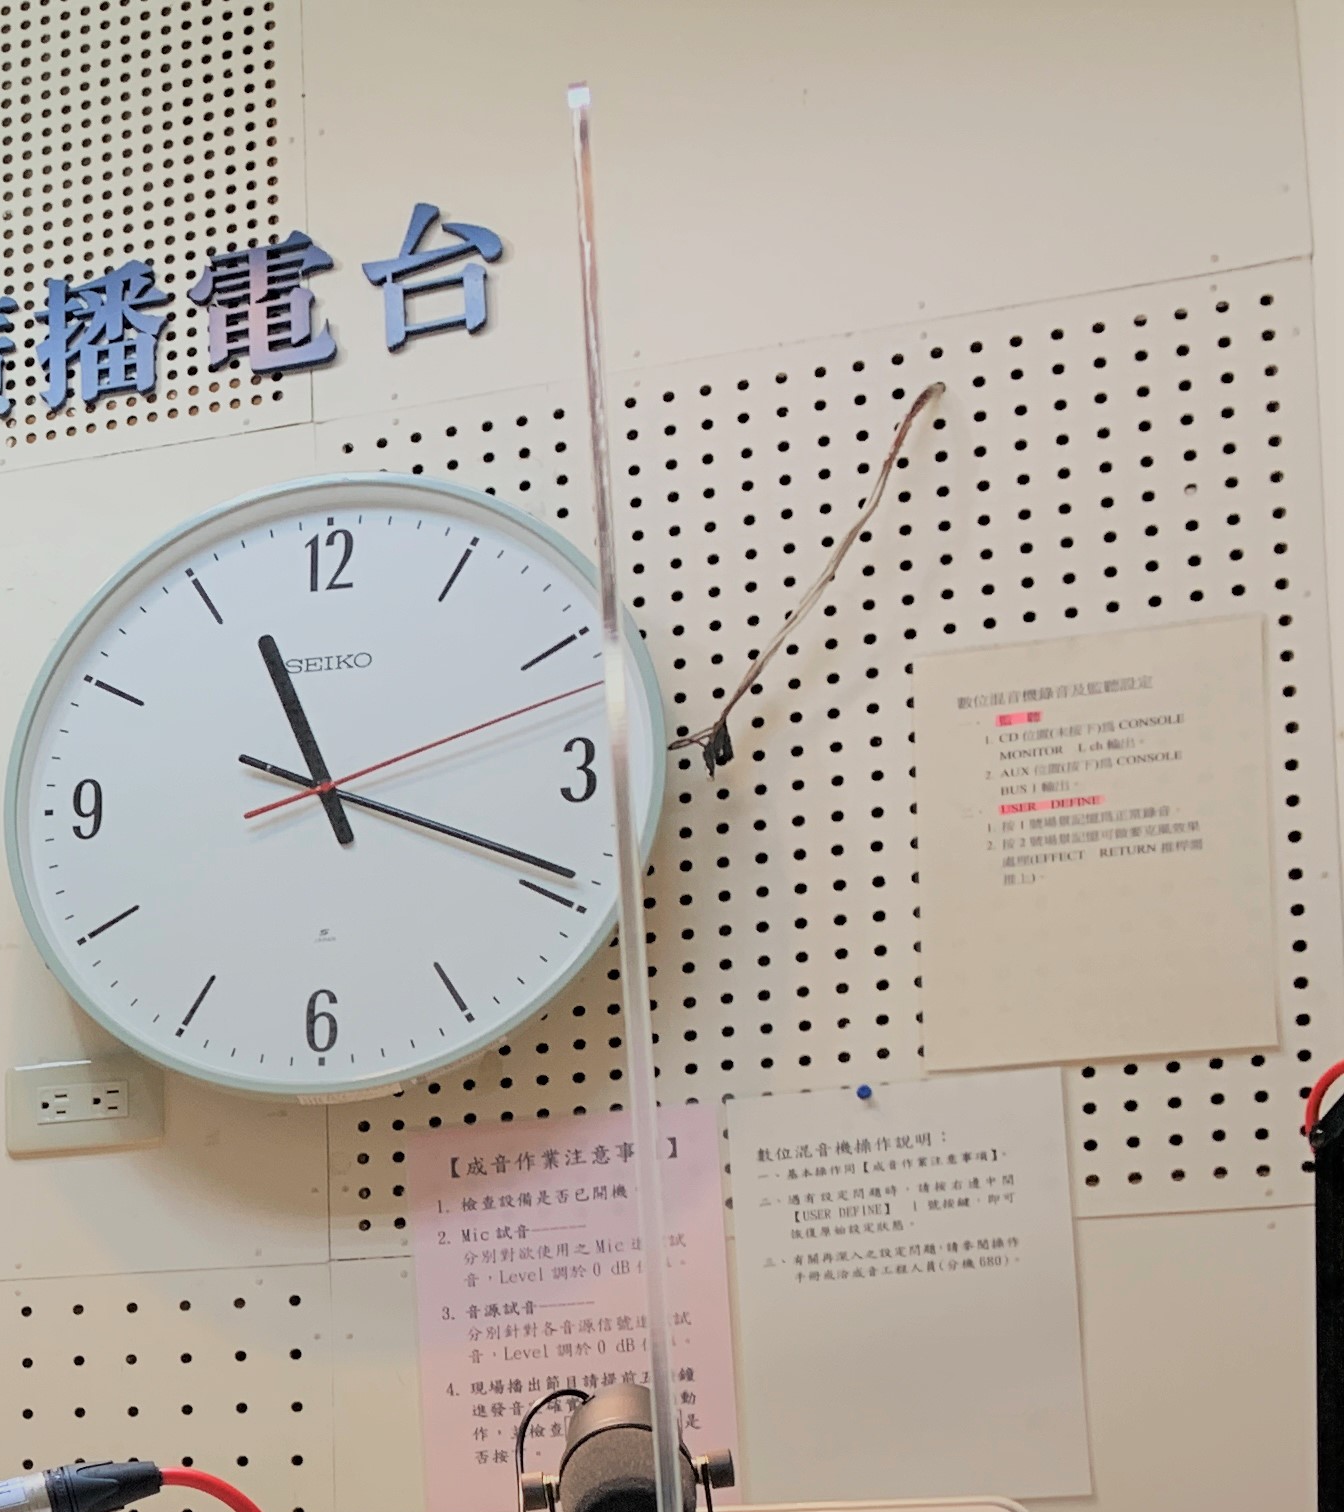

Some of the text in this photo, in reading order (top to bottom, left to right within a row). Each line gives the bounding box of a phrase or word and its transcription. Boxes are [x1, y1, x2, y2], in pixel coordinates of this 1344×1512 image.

[304, 529, 355, 593] 12
[285, 651, 373, 674] SEIKO
[998, 730, 1019, 743] CD
[1118, 713, 1185, 730] CONSOLE
[999, 744, 1063, 761] MONITOR
[560, 737, 597, 802] 3
[1000, 765, 1030, 779] AUX
[1116, 751, 1183, 766] CONSOLE
[1000, 782, 1027, 796] BUS
[72, 779, 103, 839] 9
[1001, 800, 1037, 815] USER
[1050, 795, 1101, 809] DEFINE
[1099, 844, 1156, 859] RETURN
[305, 989, 338, 1052] 6
[450, 1137, 678, 1178] 【成音作業注意事】
[437, 1200, 450, 1213] 1.
[438, 1231, 451, 1245] 2.
[462, 1229, 489, 1243] Mic
[596, 1240, 624, 1253] Mic
[611, 1260, 630, 1275] dB
[442, 1307, 455, 1320] 3.
[616, 1338, 635, 1353] dB
